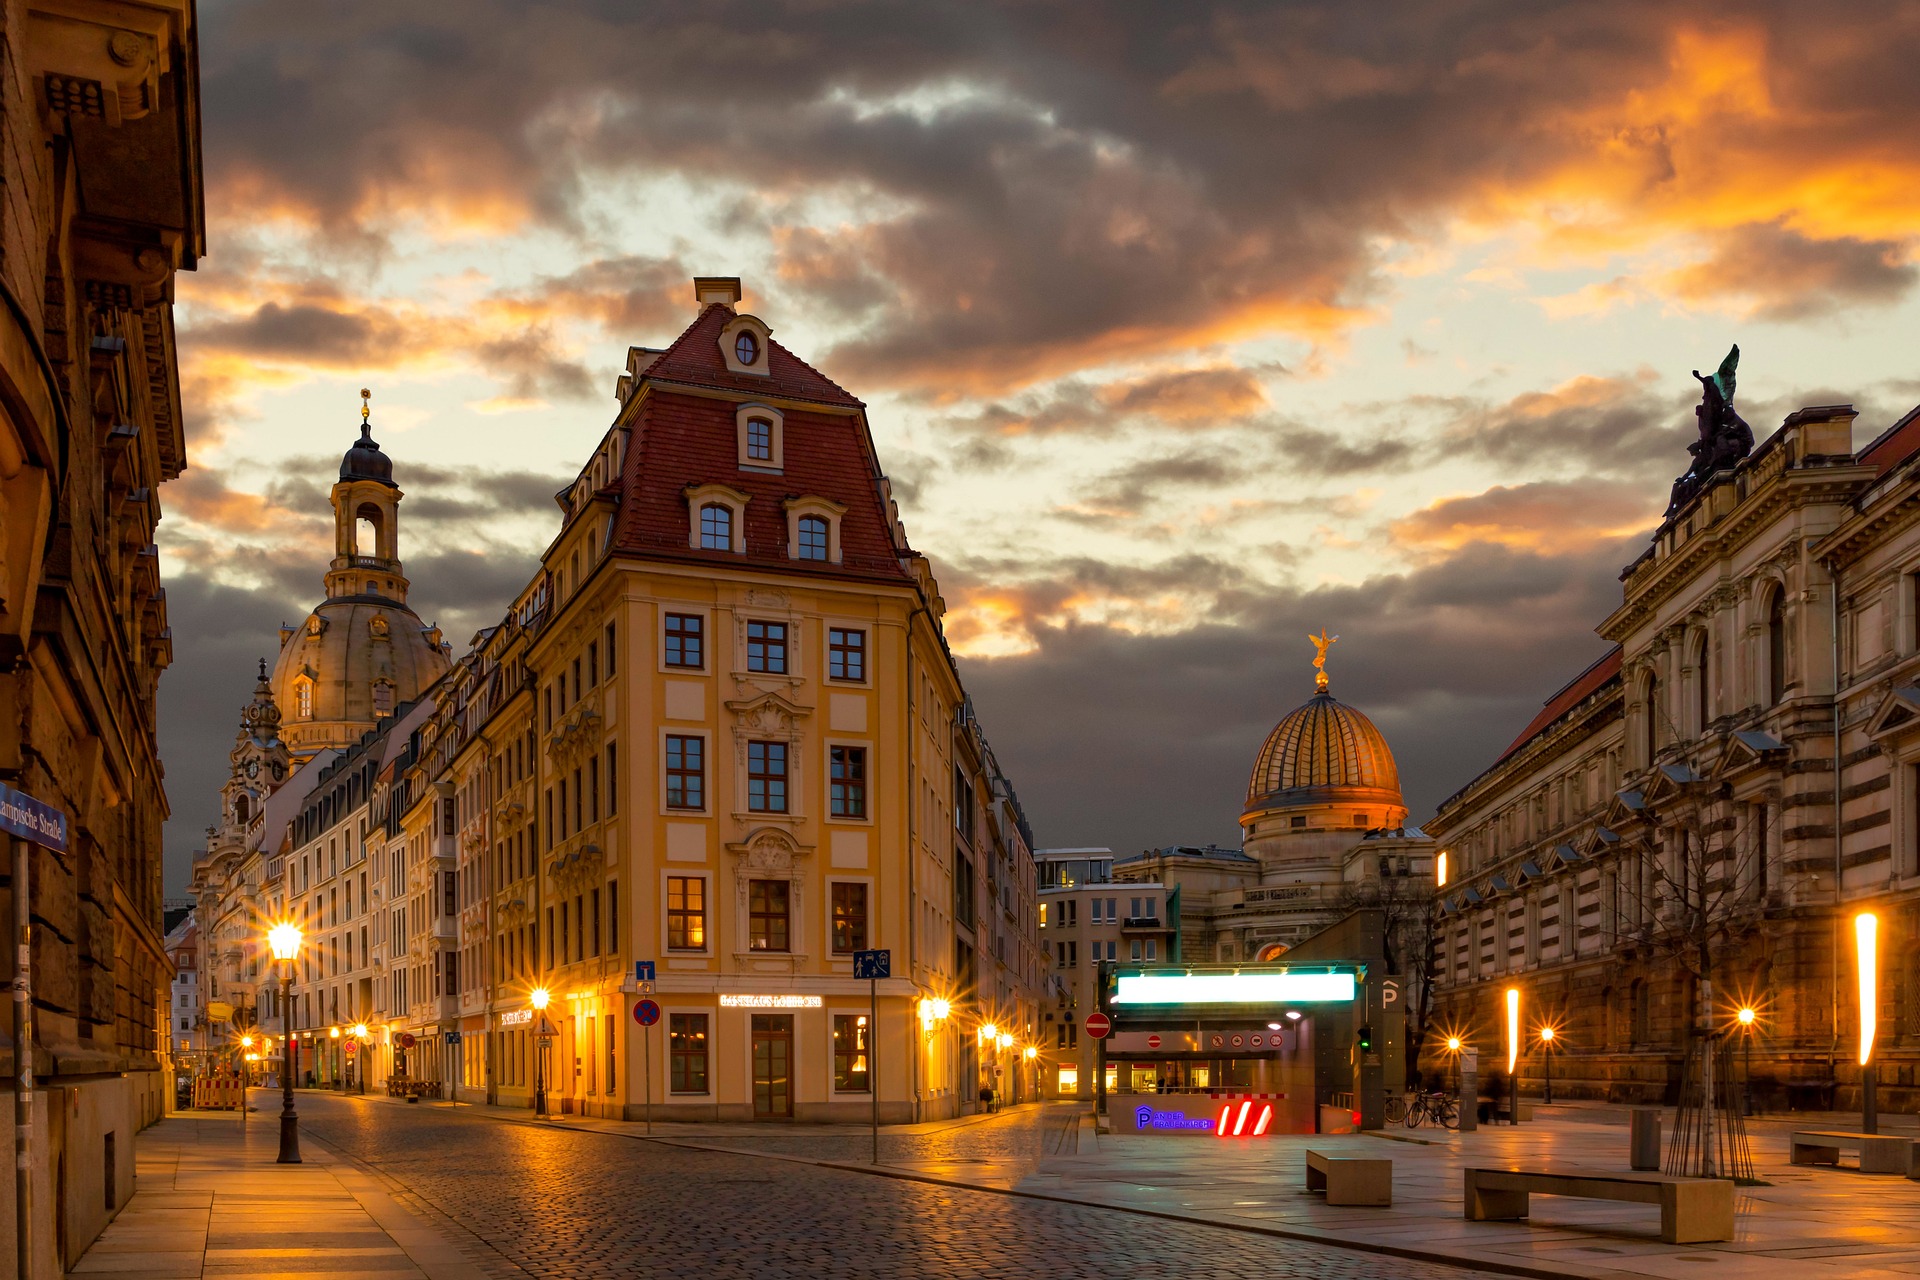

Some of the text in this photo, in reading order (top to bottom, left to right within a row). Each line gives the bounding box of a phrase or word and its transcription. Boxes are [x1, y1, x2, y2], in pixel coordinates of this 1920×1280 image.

[0, 801, 62, 841] ampische Straße
[1383, 989, 1397, 1009] P
[1140, 1113, 1150, 1128] P
